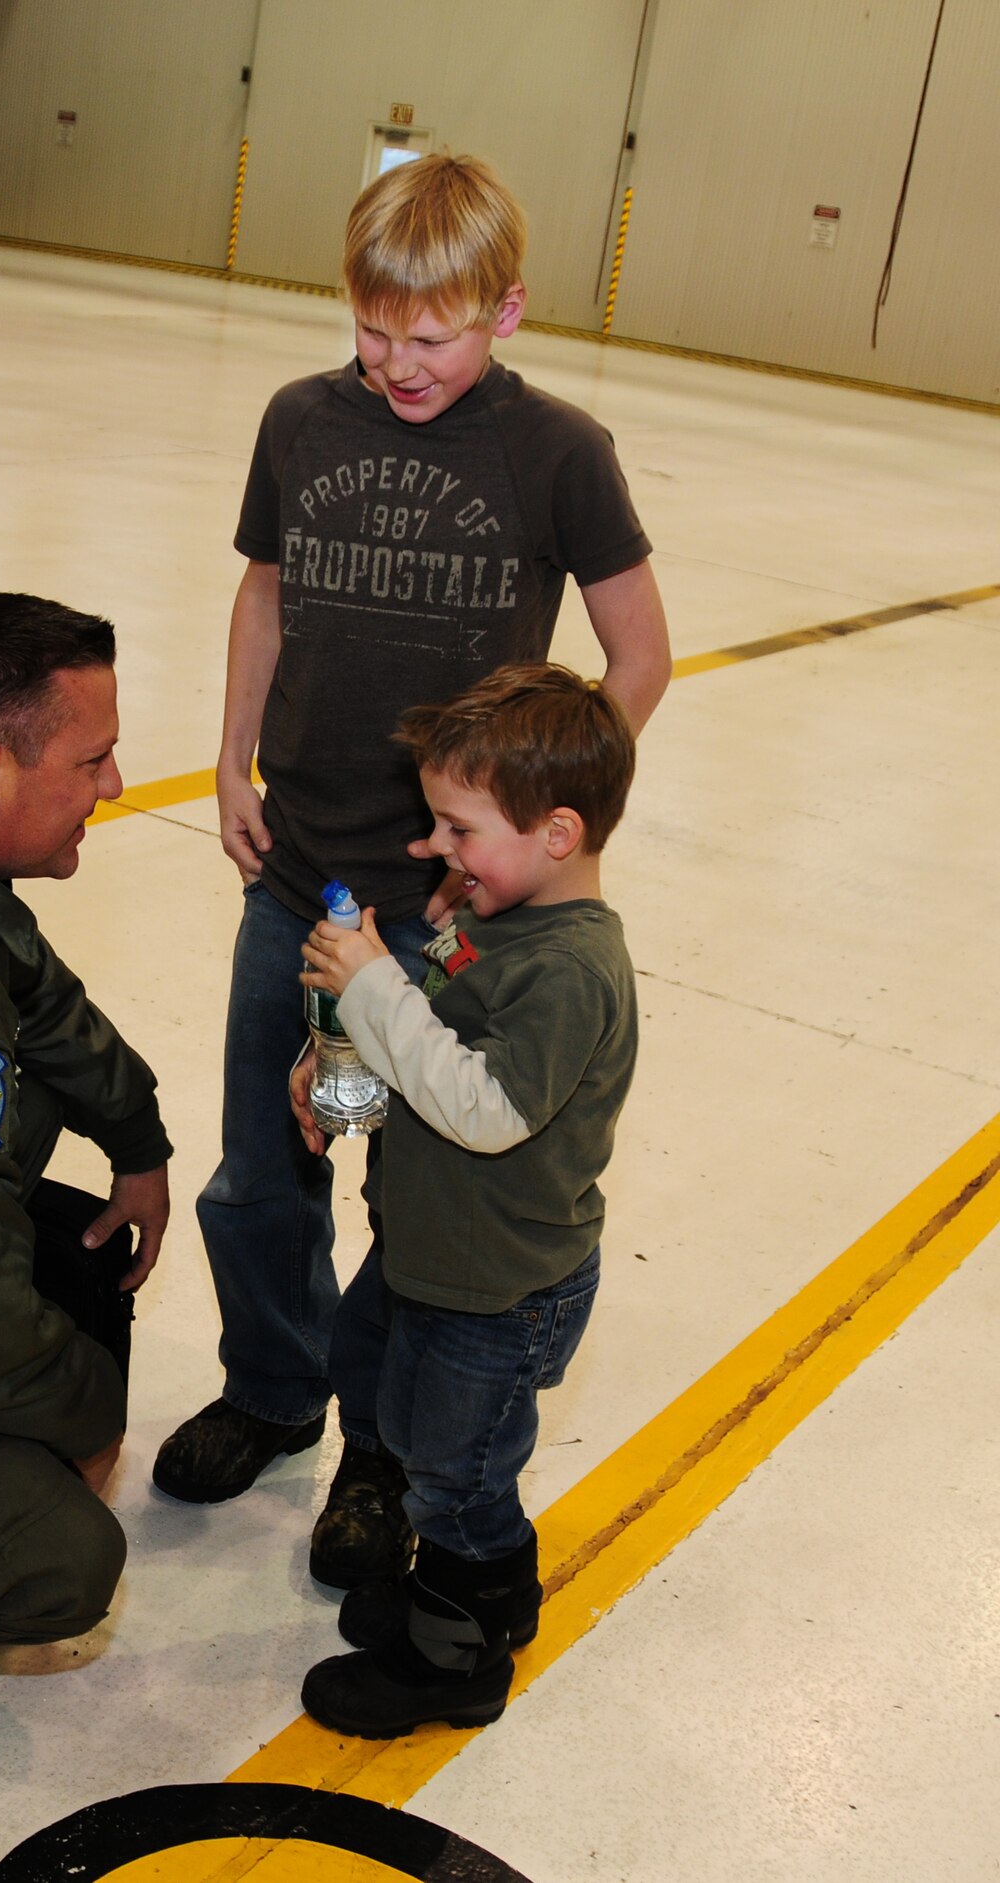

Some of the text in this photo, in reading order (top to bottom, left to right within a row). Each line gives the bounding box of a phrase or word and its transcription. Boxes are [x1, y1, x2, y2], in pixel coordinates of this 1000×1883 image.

[392, 104, 413, 122] EXIT
[299, 456, 501, 537] PROPERTY OF
[359, 502, 430, 540] 1987
[279, 527, 519, 609] ÉROPOSTALE
